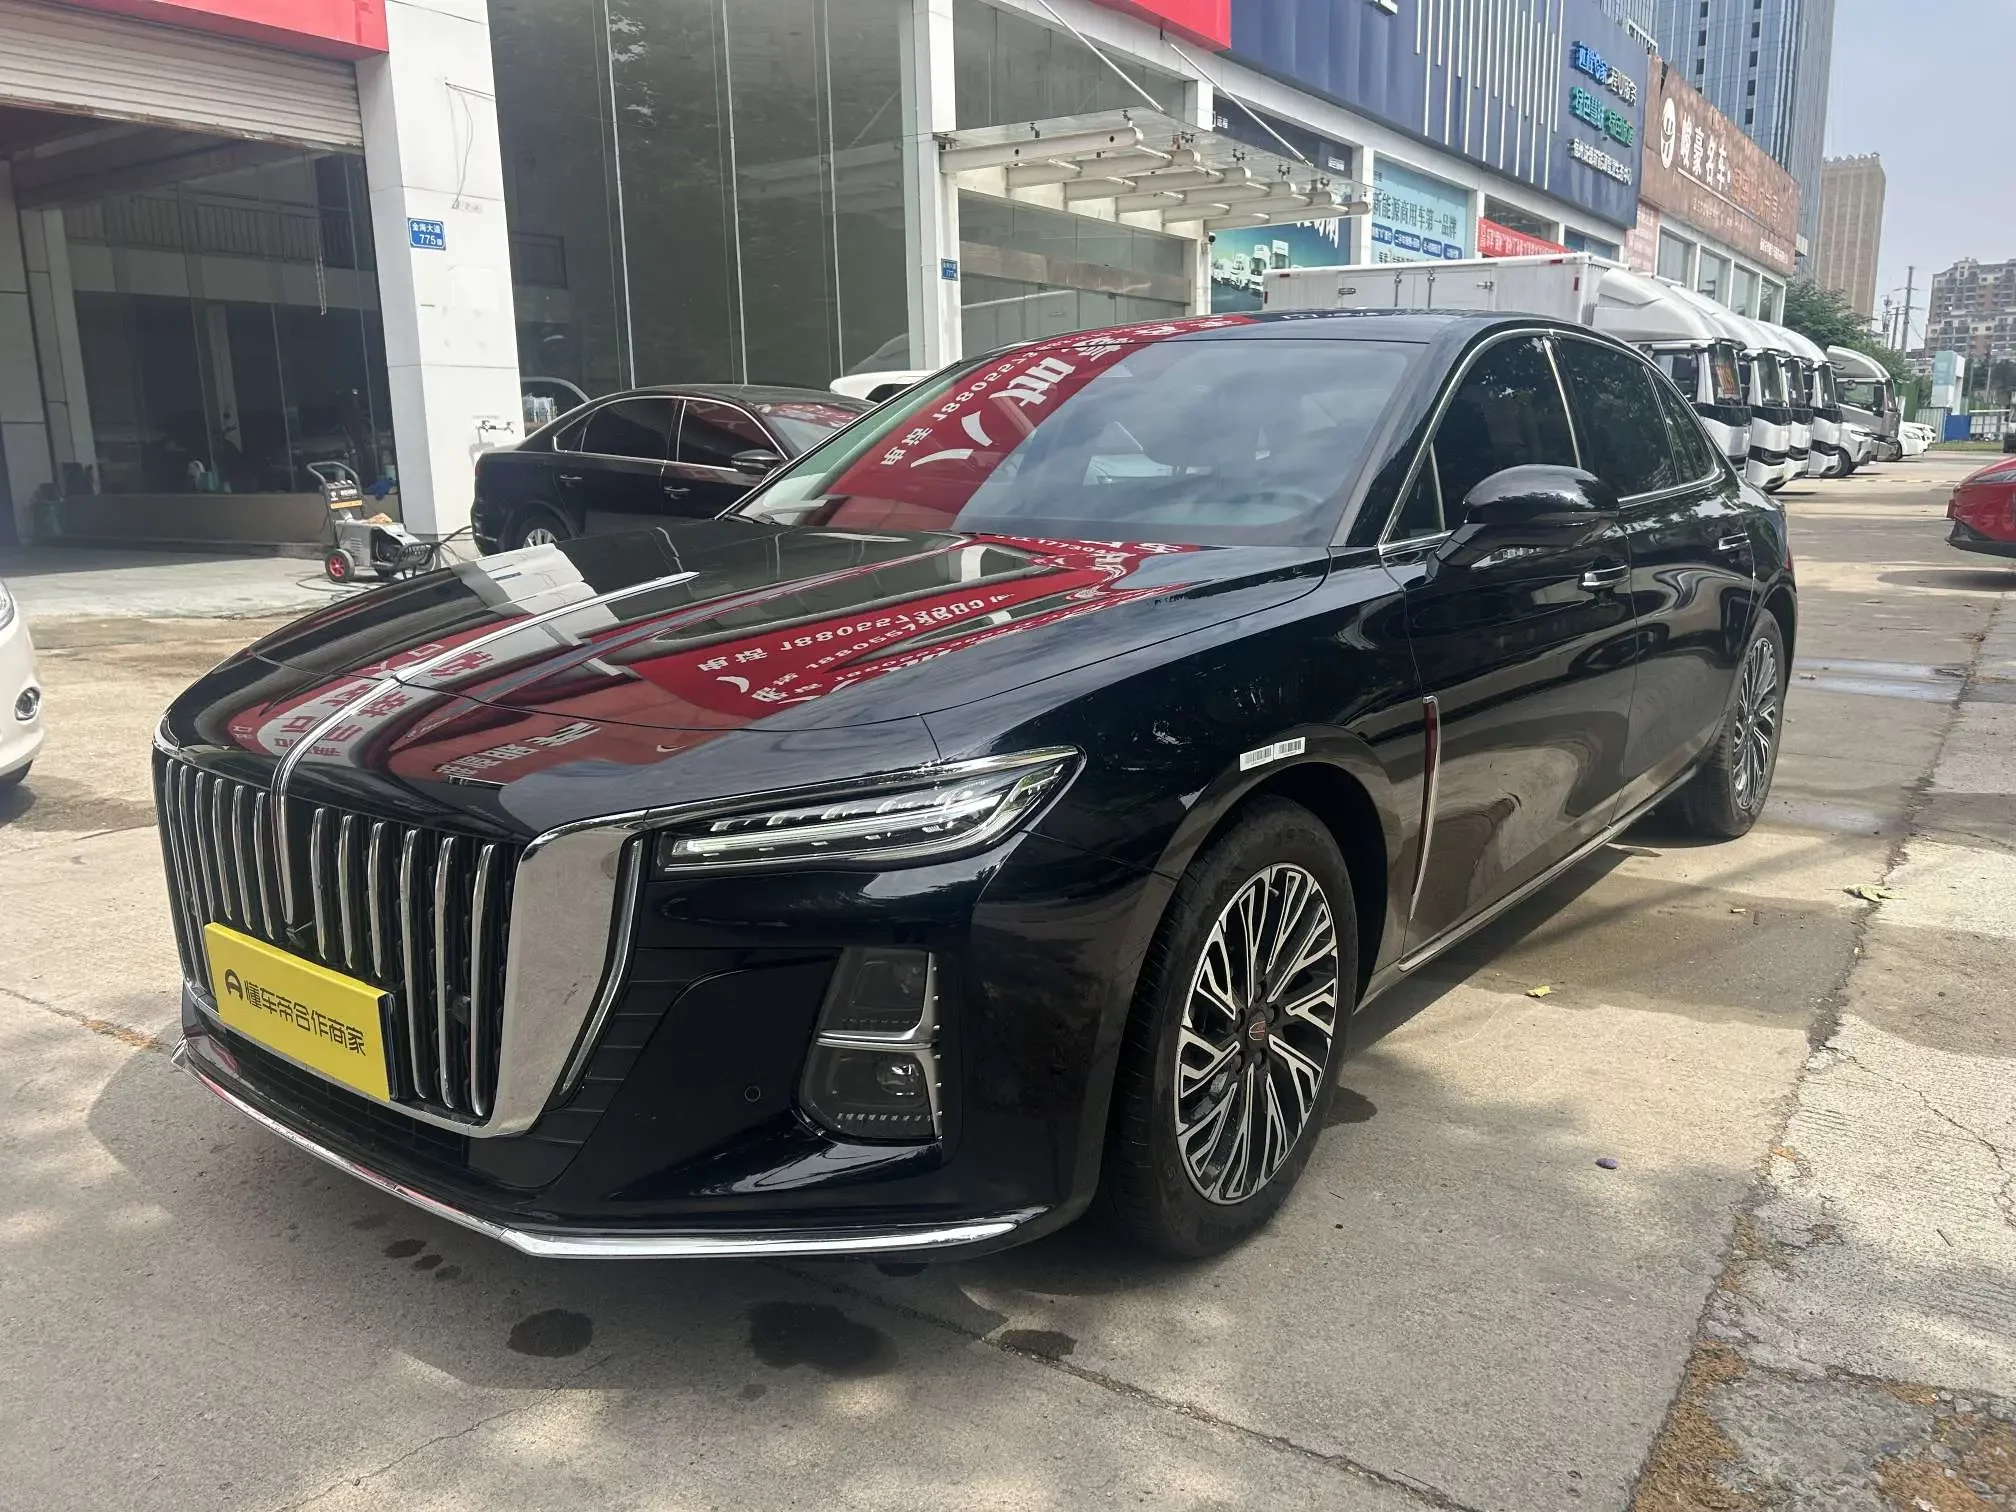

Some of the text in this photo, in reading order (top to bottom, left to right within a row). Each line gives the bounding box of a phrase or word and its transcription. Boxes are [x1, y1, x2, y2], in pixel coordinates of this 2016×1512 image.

[412, 222, 441, 233] 金海大道
[1373, 190, 1457, 239] 新能源商用车第一品牌
[245, 979, 367, 1057] 懂车帝合作商家
